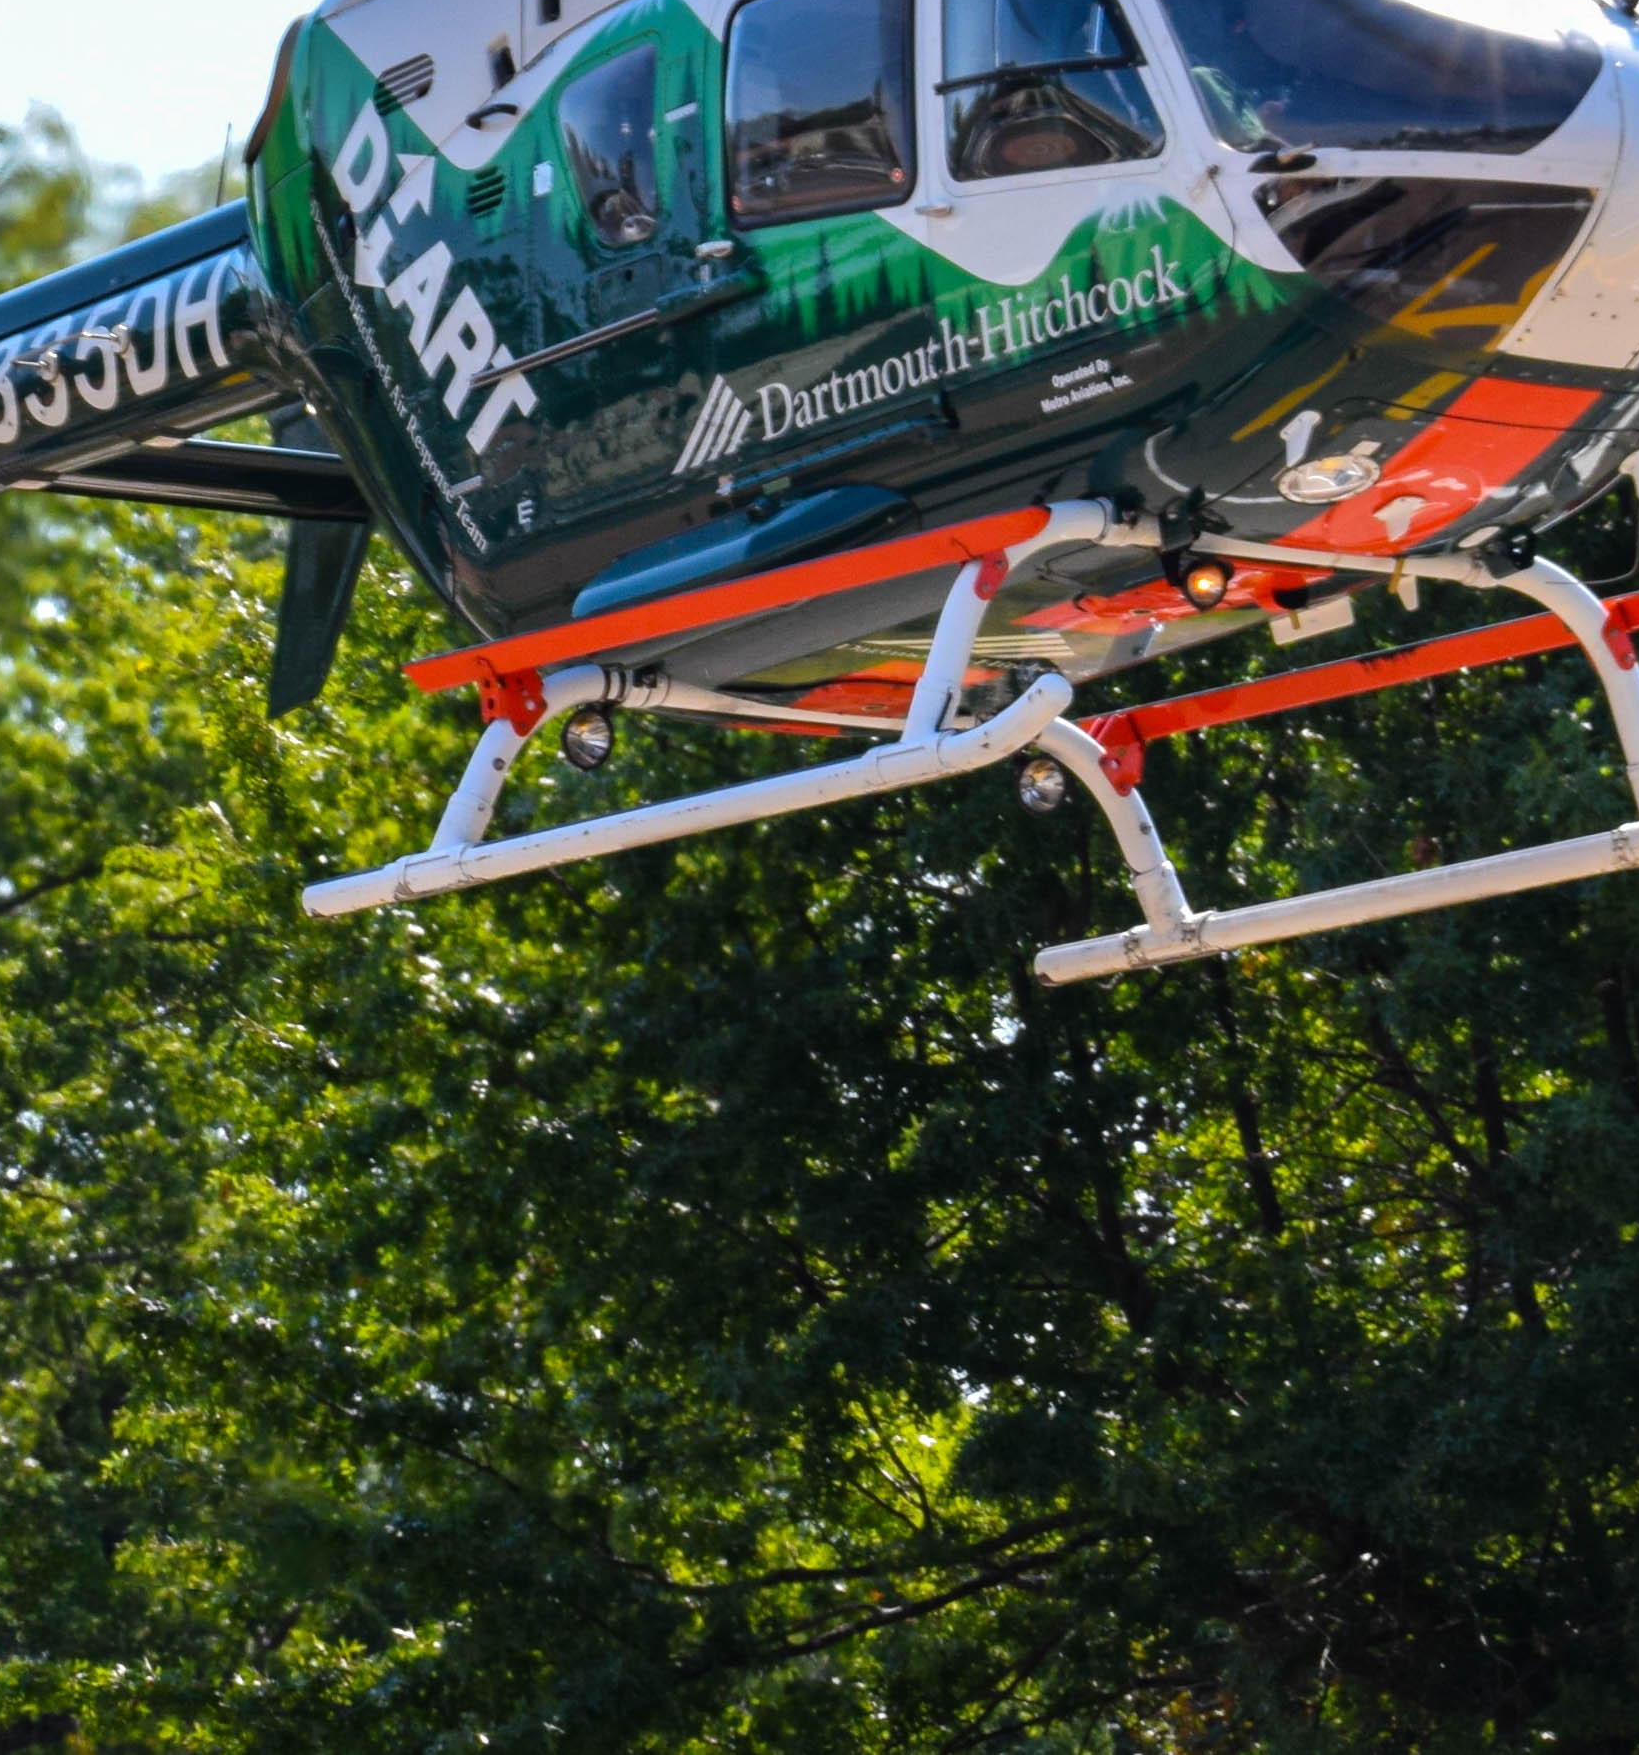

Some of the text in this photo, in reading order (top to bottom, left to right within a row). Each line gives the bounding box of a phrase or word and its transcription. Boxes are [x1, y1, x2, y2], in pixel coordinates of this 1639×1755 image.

[756, 244, 1189, 441] Dartmouth-Hitchcock
[389, 384, 408, 418] Air
[407, 415, 454, 504] Response
[456, 496, 489, 554] Team
